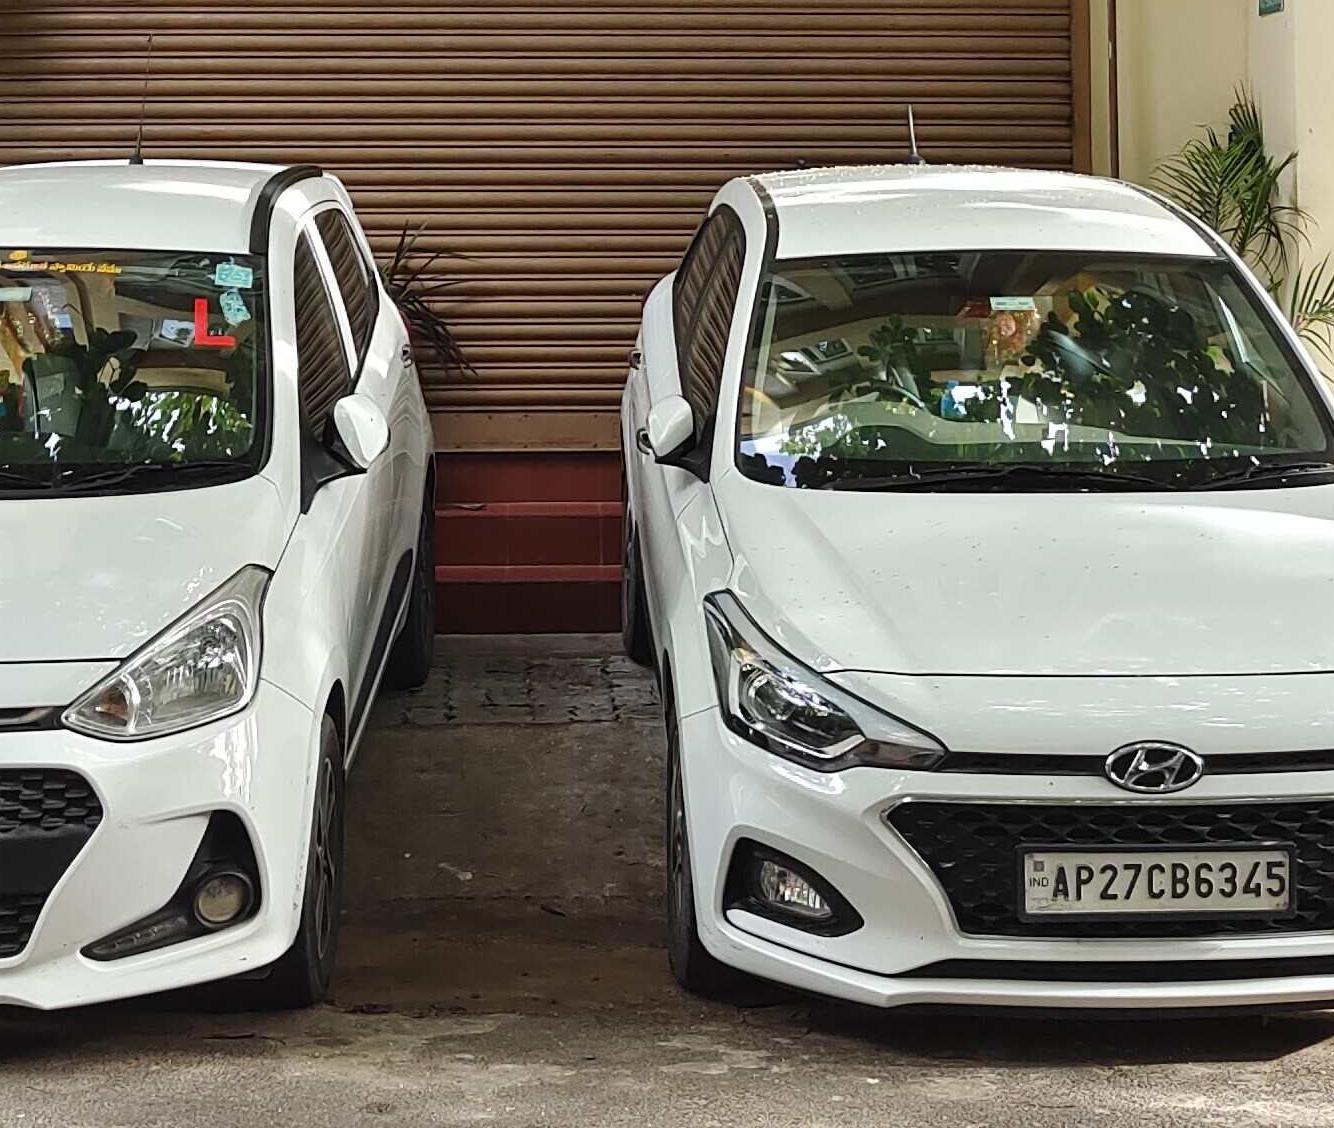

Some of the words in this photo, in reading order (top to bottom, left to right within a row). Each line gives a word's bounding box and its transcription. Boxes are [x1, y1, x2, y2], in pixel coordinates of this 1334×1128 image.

[194, 298, 236, 347] L
[1029, 877, 1049, 888] IND
[1052, 861, 1286, 901] AP27CB6345
